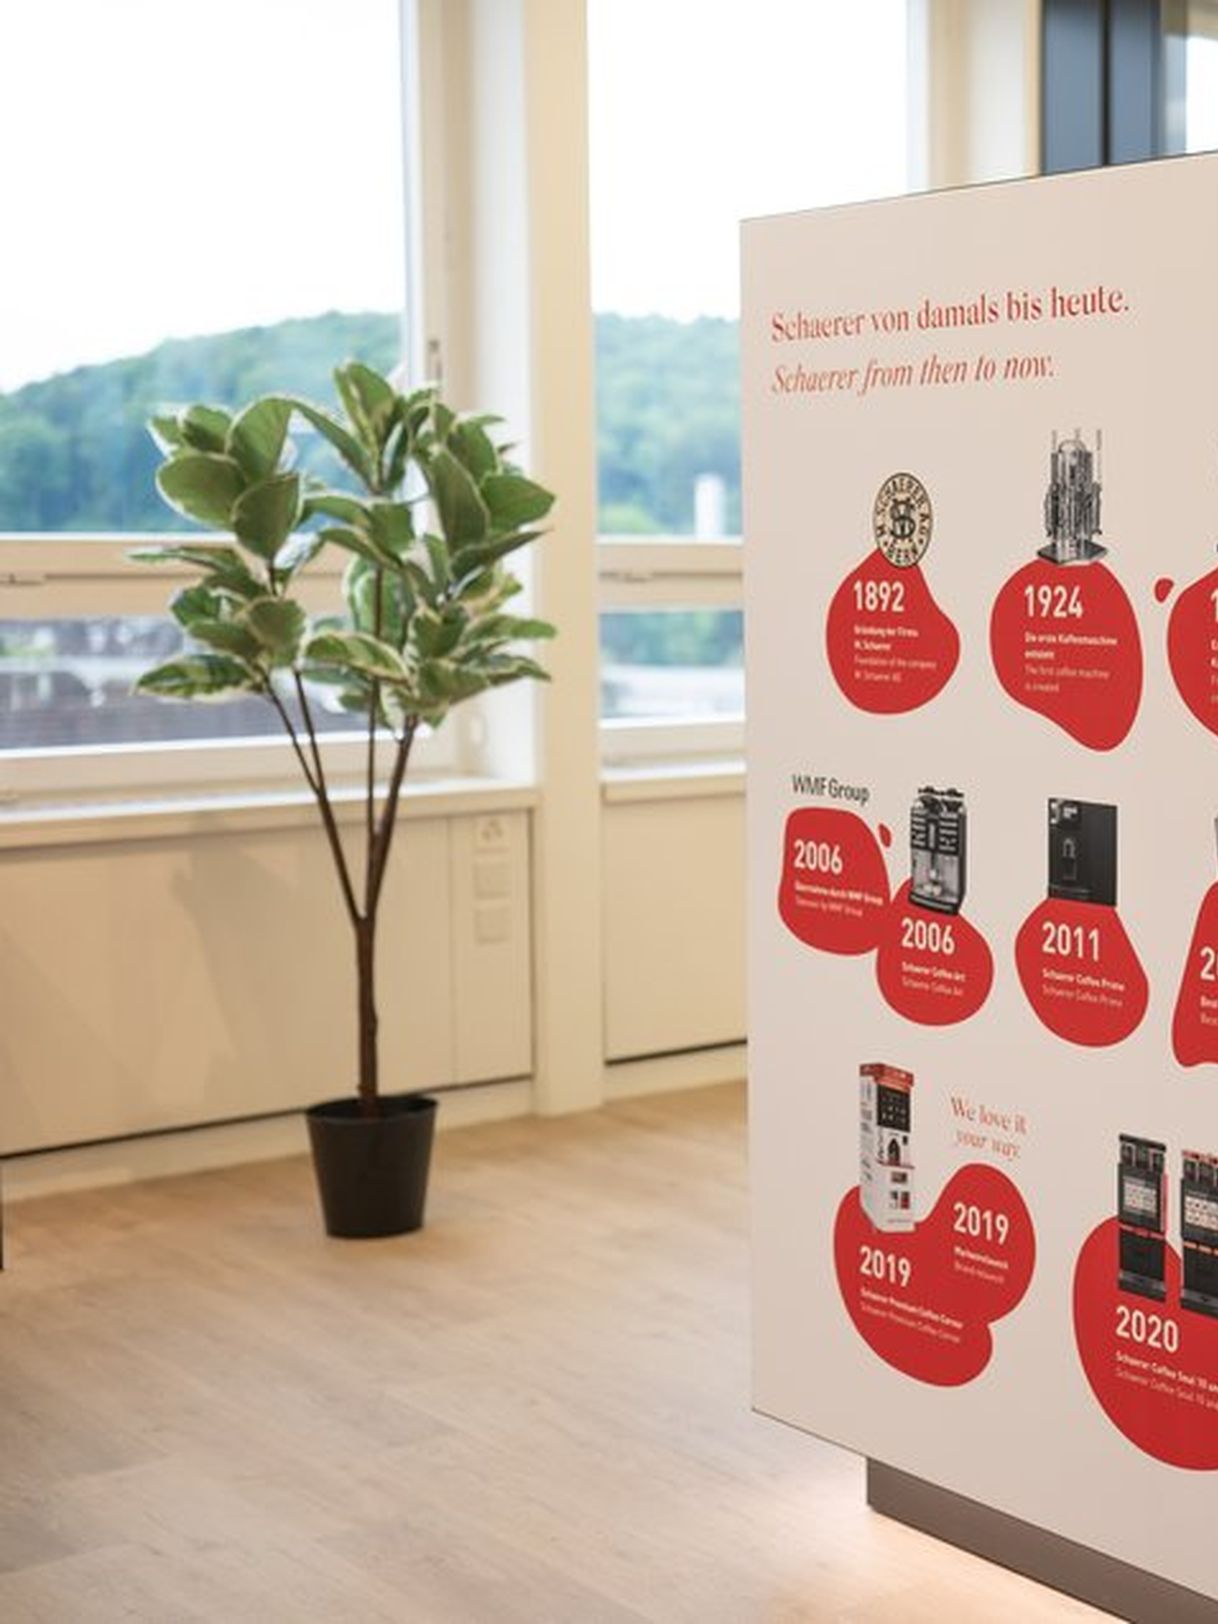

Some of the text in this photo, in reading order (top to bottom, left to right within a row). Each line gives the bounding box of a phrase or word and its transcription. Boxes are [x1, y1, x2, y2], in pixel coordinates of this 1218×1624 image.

[772, 286, 1130, 342] Schaerer von damals bis heute.
[772, 354, 1053, 397] Schaerer from then to now.
[854, 580, 905, 612] 1892
[1024, 584, 1084, 618] 1924
[792, 774, 870, 807] WMF Group
[793, 839, 843, 875] 2006
[902, 917, 955, 955] 2006
[1042, 921, 1099, 962] 2011
[1076, 974, 1100, 988] Coffee
[951, 1096, 1027, 1135] We love it
[953, 1202, 1009, 1245] 2019
[860, 1244, 911, 1287] 2019
[1115, 1305, 1179, 1353] 2020
[1115, 1350, 1150, 1369] Schaerer
[1151, 1361, 1177, 1379] Coffee
[1178, 1370, 1195, 1385] Soul
[1115, 1366, 1149, 1385] Schaerer
[1150, 1377, 1175, 1395] Coffee
[1176, 1386, 1194, 1401] Soul
